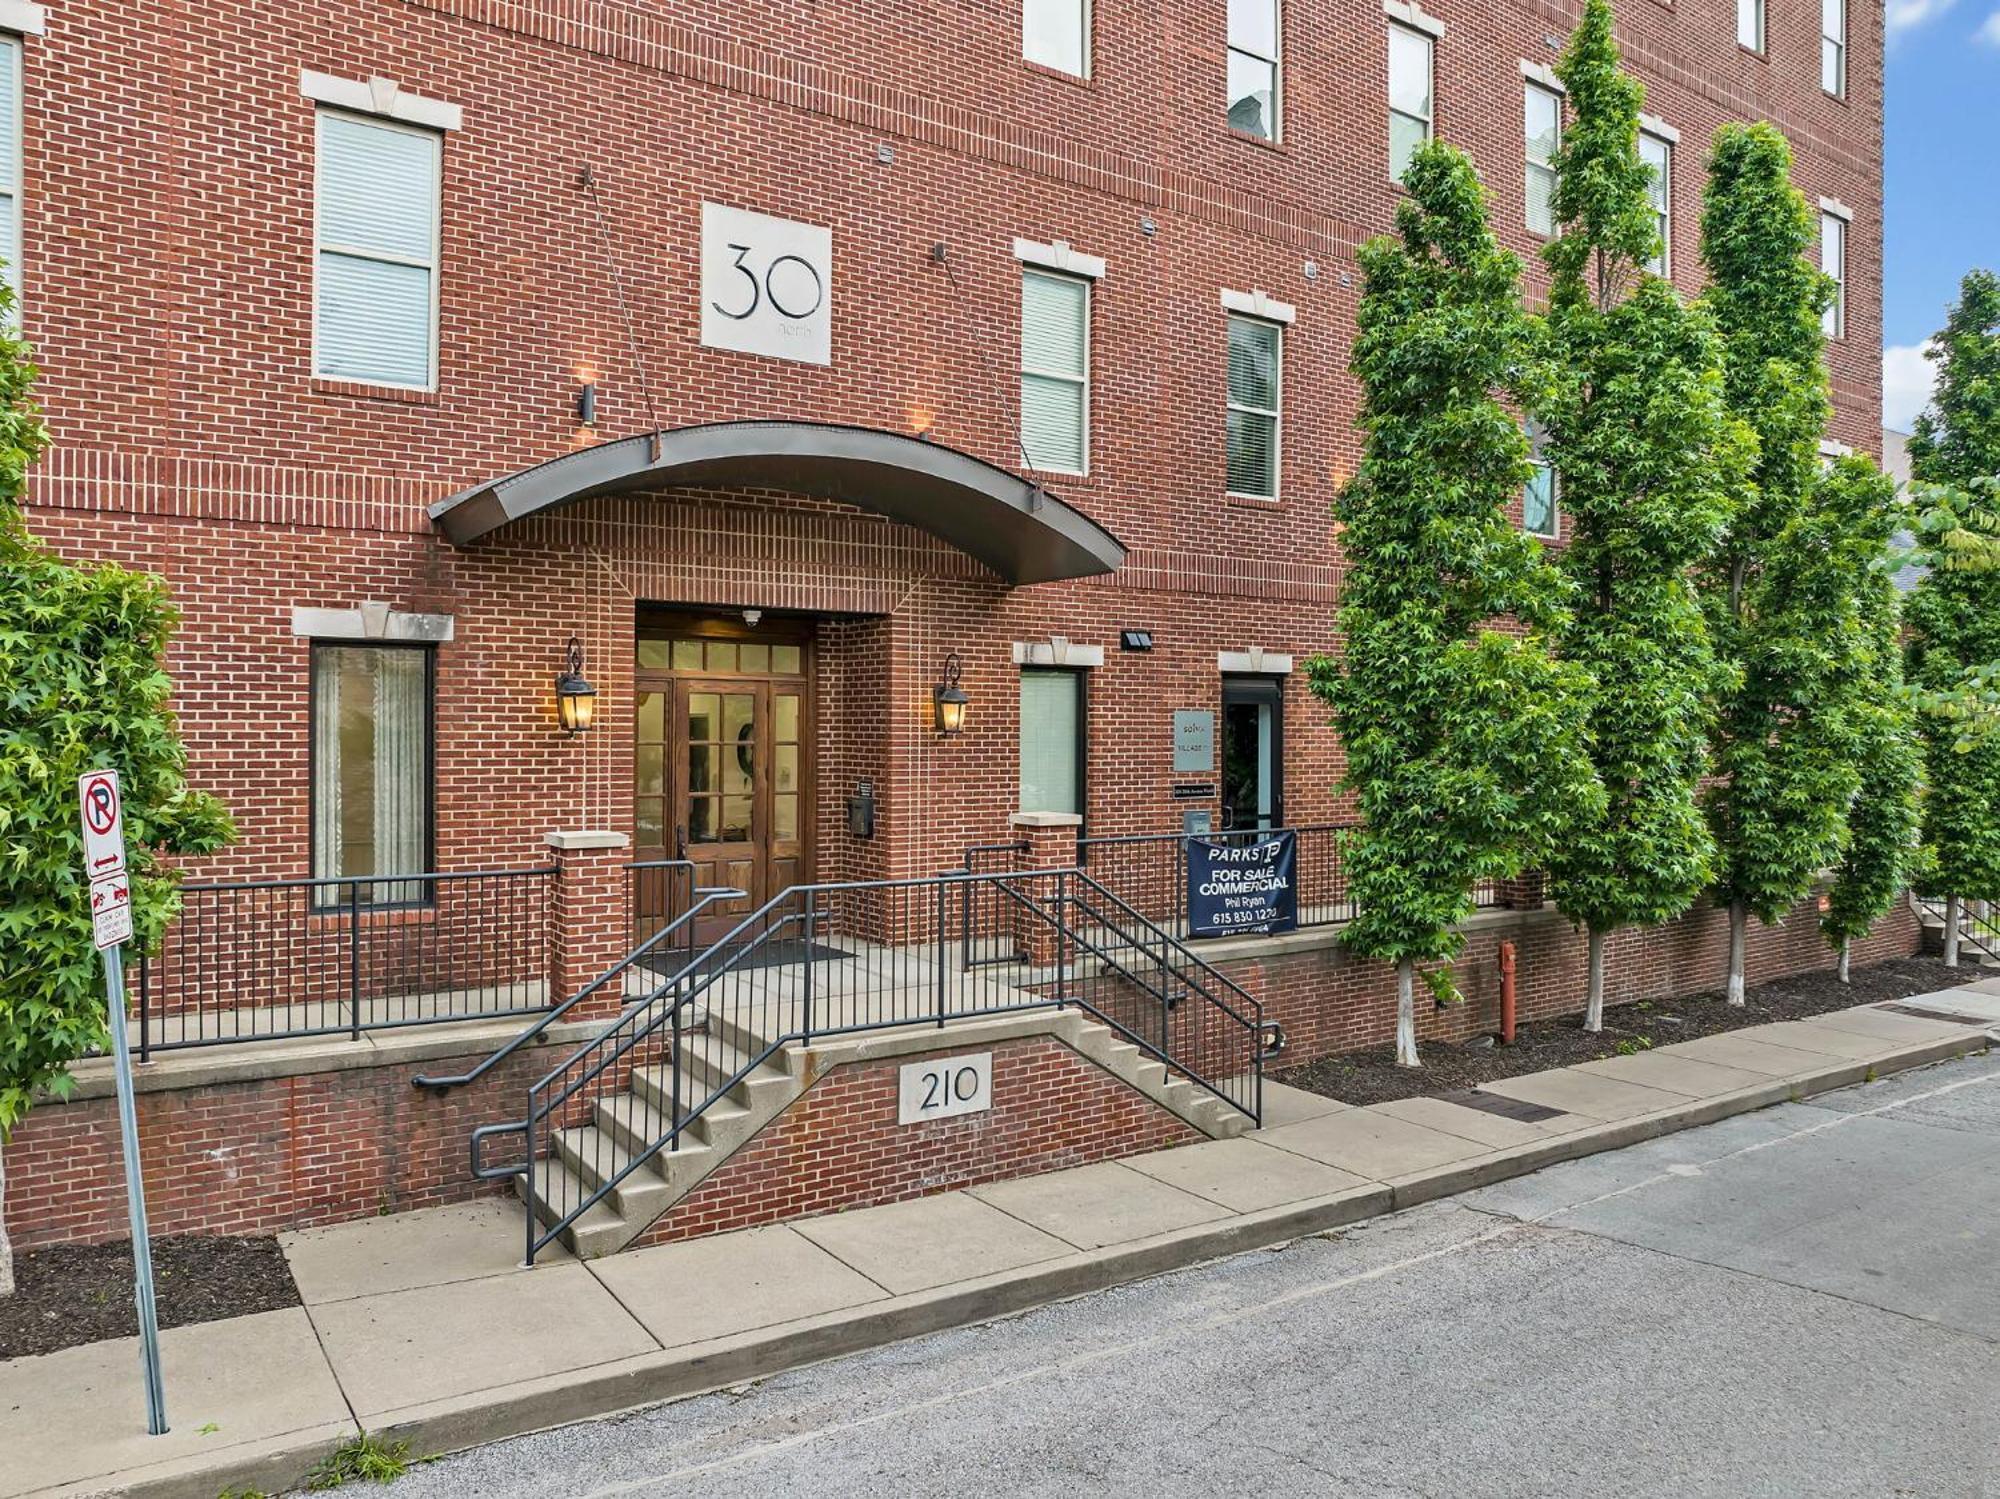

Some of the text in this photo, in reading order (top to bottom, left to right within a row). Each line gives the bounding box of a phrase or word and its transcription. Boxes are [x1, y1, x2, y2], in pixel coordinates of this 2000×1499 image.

[711, 243, 822, 320] 30
[1208, 847, 1260, 862] PARKS
[1211, 865, 1276, 882] FOR SALE
[1199, 876, 1289, 896] COMMERCIAL
[1224, 896, 1266, 909] Phil Ryan
[1212, 912, 1232, 925] 615
[1233, 910, 1253, 923] 830
[920, 1066, 978, 1110] 210
